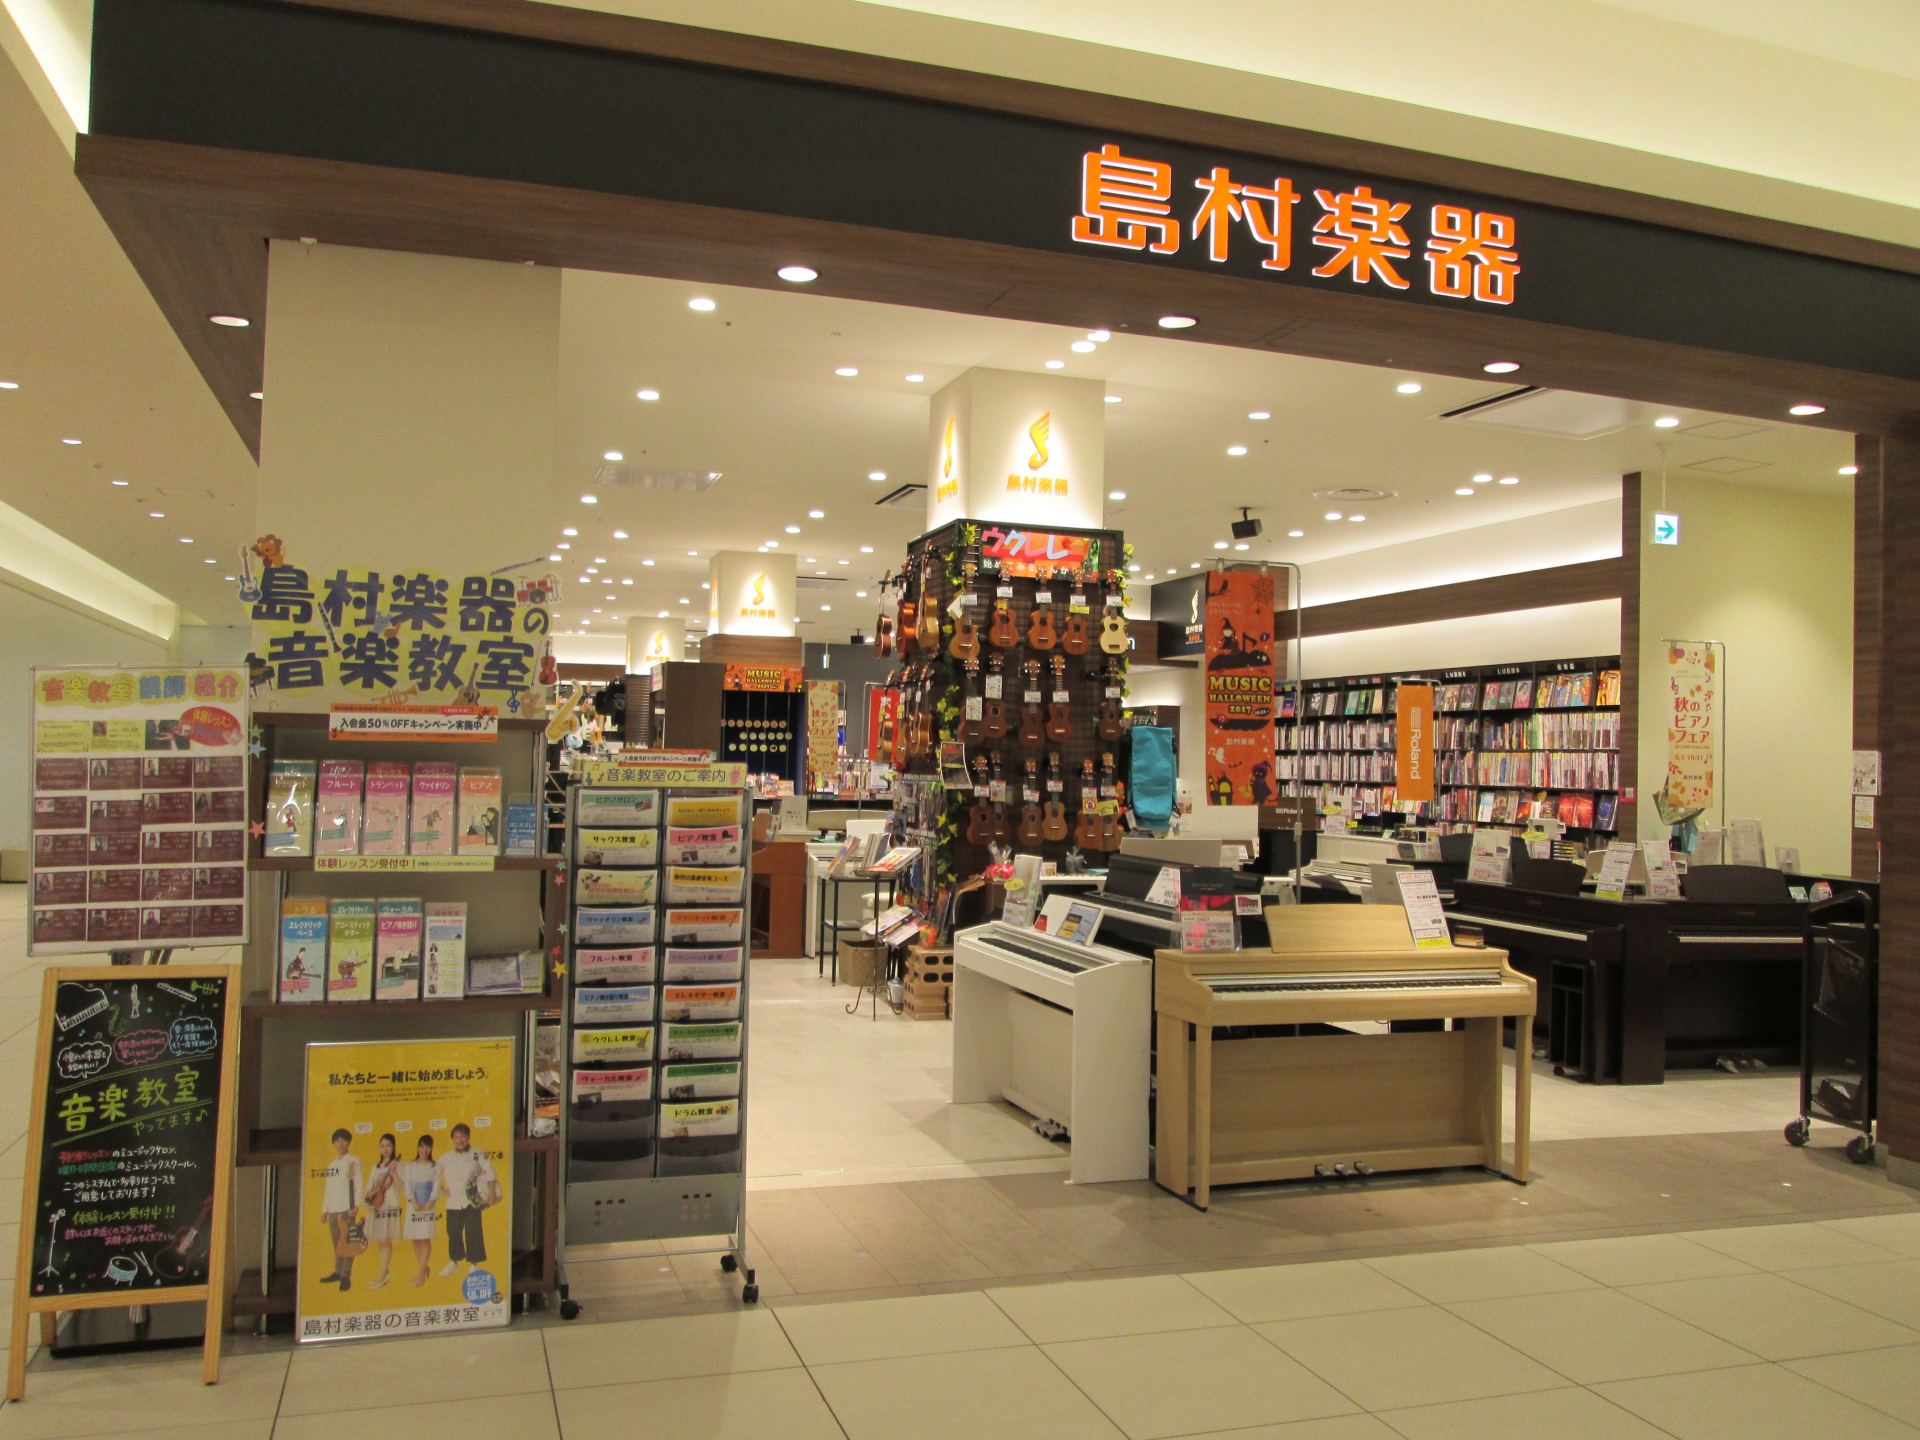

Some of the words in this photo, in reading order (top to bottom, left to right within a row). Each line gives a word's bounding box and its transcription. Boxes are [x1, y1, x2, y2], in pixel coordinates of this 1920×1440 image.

[1072, 144, 1521, 305] 島村楽器
[251, 565, 550, 636] 島村楽器の
[267, 630, 536, 694] 音楽教室
[746, 669, 782, 679] MUSIC
[1209, 676, 1272, 692] MUSIC
[1209, 693, 1271, 703] HALLOWEEN
[1228, 704, 1253, 714] 2017
[1673, 697, 1701, 713] 秋の
[1674, 715, 1710, 729] ピアノ
[1674, 729, 1711, 744] フェア
[1410, 728, 1422, 780] Roland
[606, 767, 727, 783] 音楽教室のご案内
[326, 780, 356, 789] フルート
[370, 780, 405, 790] トランペット
[469, 781, 493, 791] ピアノ
[1283, 807, 1304, 815] Rolad
[592, 835, 637, 844] サックス教室
[589, 954, 633, 962] フルート教室
[592, 1034, 637, 1044] ウクレレ教室
[58, 1065, 200, 1133] 音楽教室
[674, 1107, 714, 1118] ドラム教室
[303, 1306, 481, 1336] 島村楽器の音楽教室
